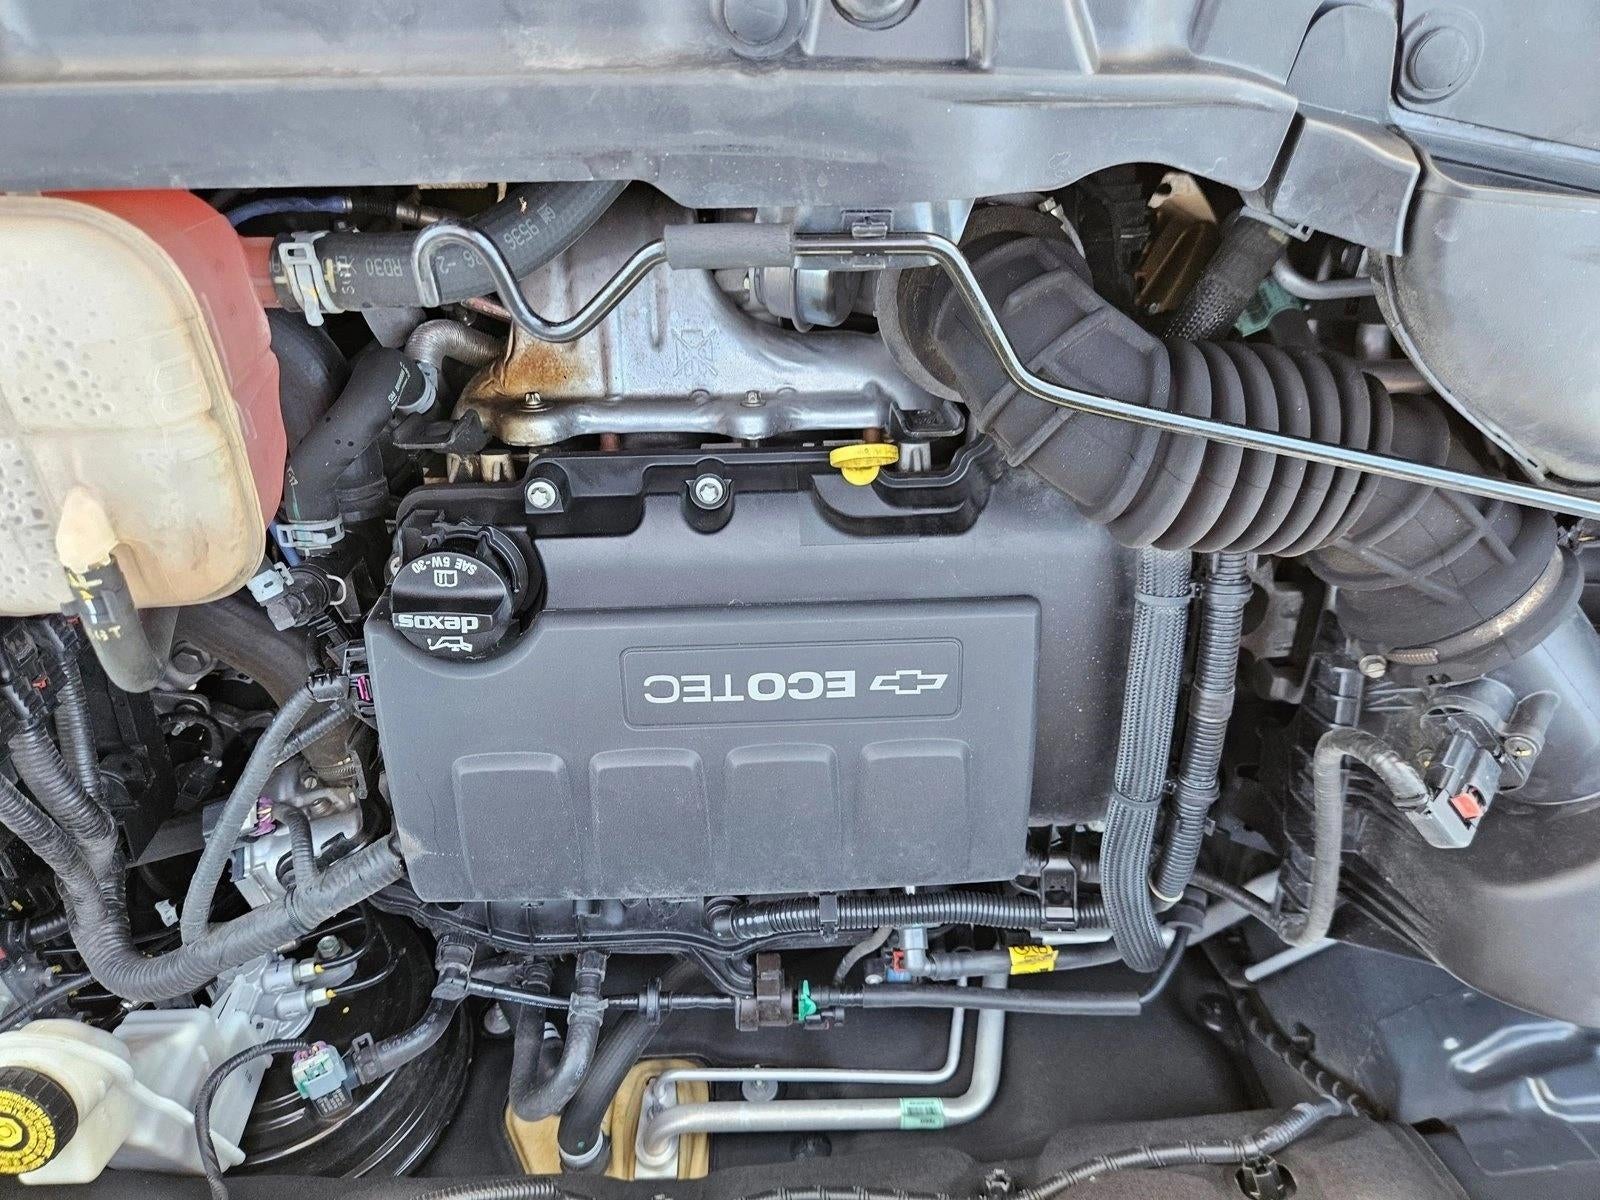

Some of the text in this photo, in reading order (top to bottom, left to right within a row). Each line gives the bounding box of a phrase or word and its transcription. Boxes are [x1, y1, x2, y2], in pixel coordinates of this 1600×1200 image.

[502, 219, 538, 250] 9536
[364, 259, 403, 277] RD30
[411, 556, 478, 576] SAE 5W-30
[397, 614, 479, 633] dexos
[643, 671, 857, 705] ECOTEC
